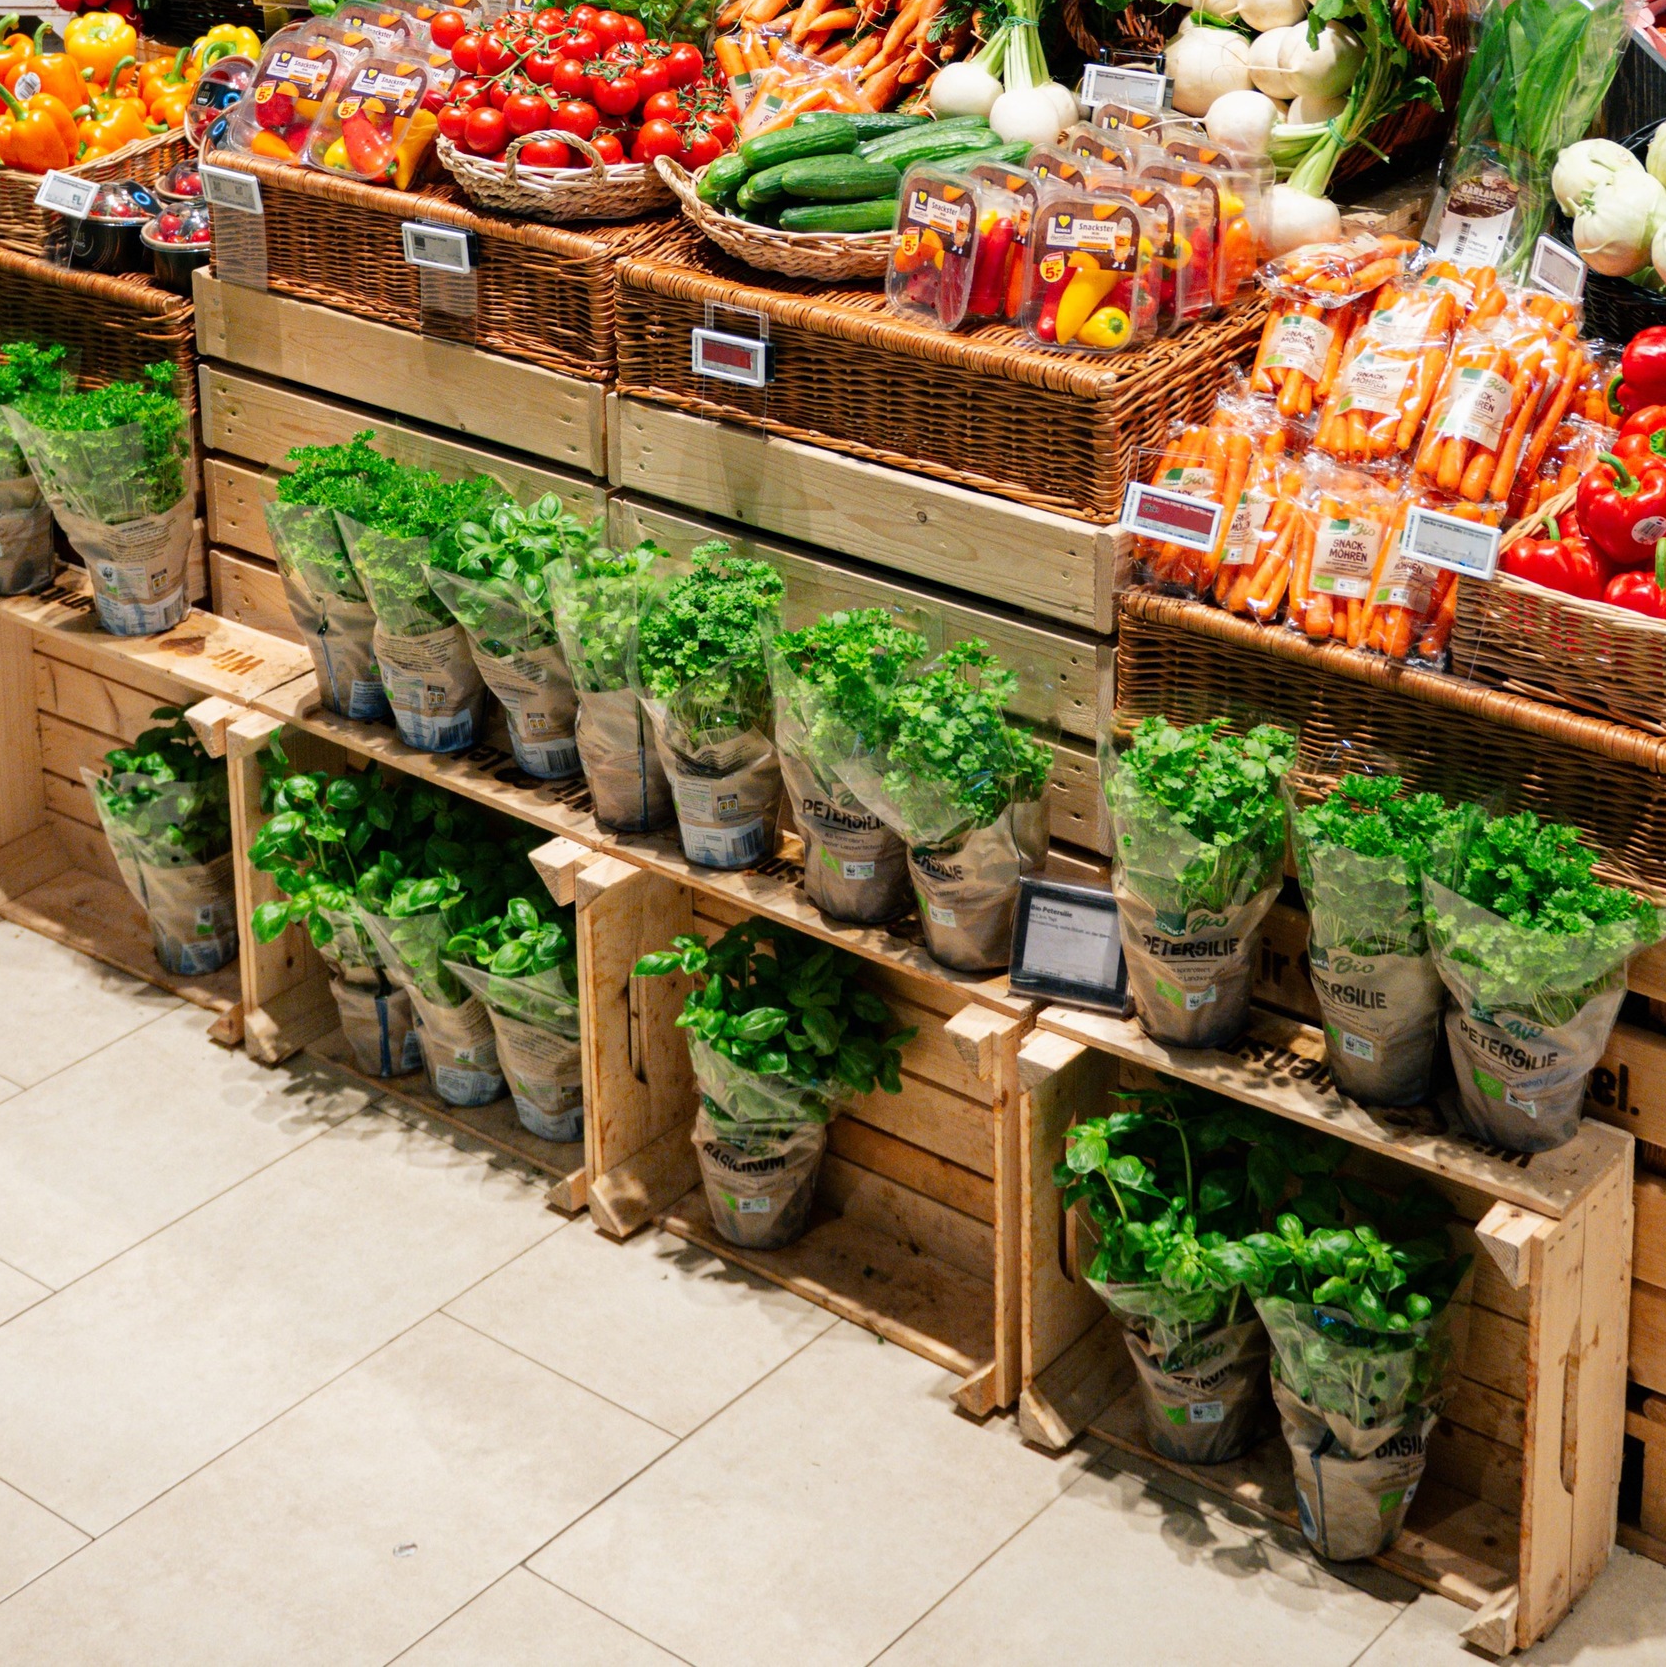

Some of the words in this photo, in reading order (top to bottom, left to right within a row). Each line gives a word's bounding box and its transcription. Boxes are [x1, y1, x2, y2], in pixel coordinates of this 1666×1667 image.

[931, 202, 958, 217] Snackster
[1078, 222, 1114, 233] Snackster
[1332, 537, 1367, 552] SNACK-
[1328, 546, 1368, 564] MÖHREN
[802, 799, 886, 831] PETERSILI
[1043, 907, 1073, 919] Petersilie
[1141, 934, 1239, 959] PETERSILIE
[1333, 955, 1375, 975] Bio
[1460, 1019, 1558, 1072] PETERSILIE
